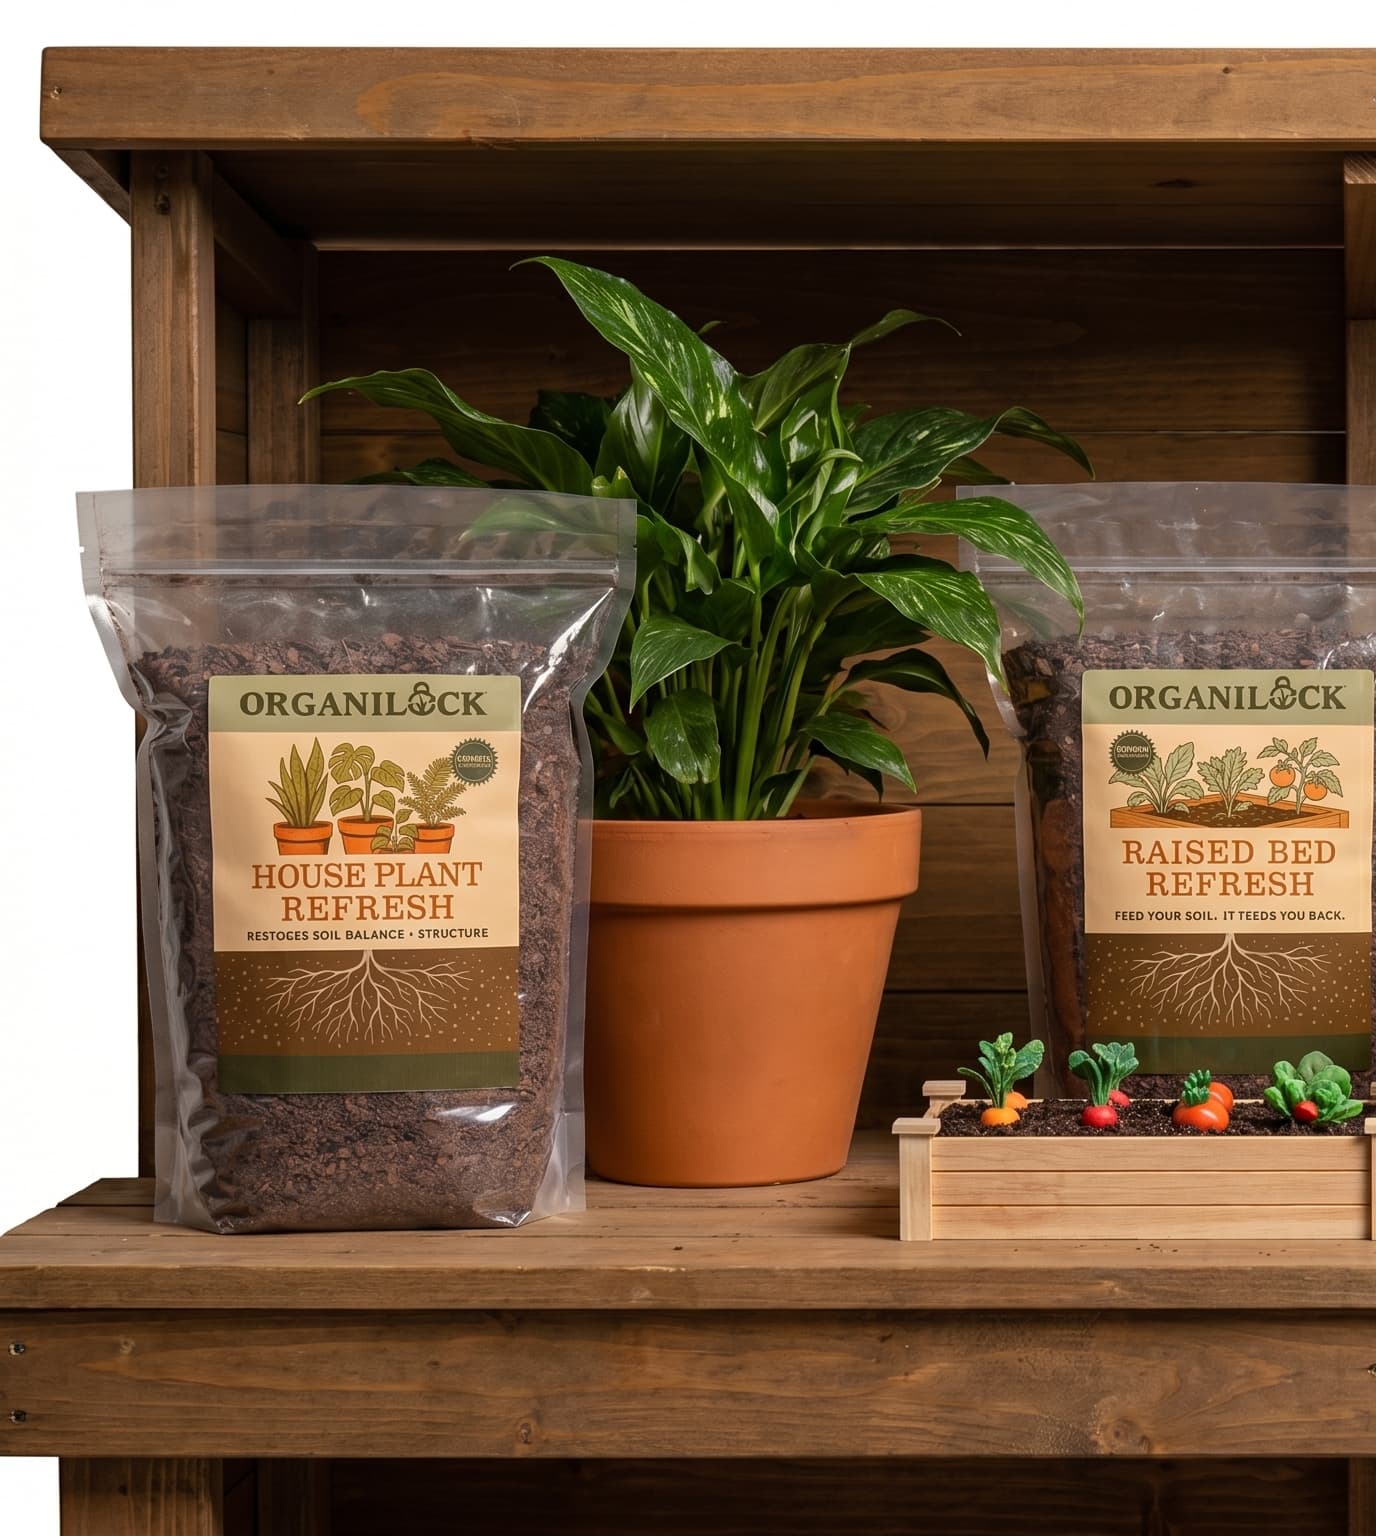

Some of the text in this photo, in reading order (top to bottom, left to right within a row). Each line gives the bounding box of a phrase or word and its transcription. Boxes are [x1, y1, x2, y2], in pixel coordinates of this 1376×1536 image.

[1121, 839, 1336, 865] RAISED BED
[251, 861, 483, 890] HOUSE PLANT
[1145, 871, 1314, 897] REFRESH
[281, 894, 454, 922] REFRESH
[1115, 910, 1145, 921] FEED
[1147, 911, 1182, 921] YOUR
[1185, 911, 1218, 921] SOIL.
[1223, 910, 1234, 921] IT
[1280, 910, 1305, 921] YOU
[1308, 910, 1345, 921] BACK.
[312, 930, 341, 941] SOIL
[345, 929, 405, 940] BALANCE
[418, 928, 489, 939] STRUCTURE
